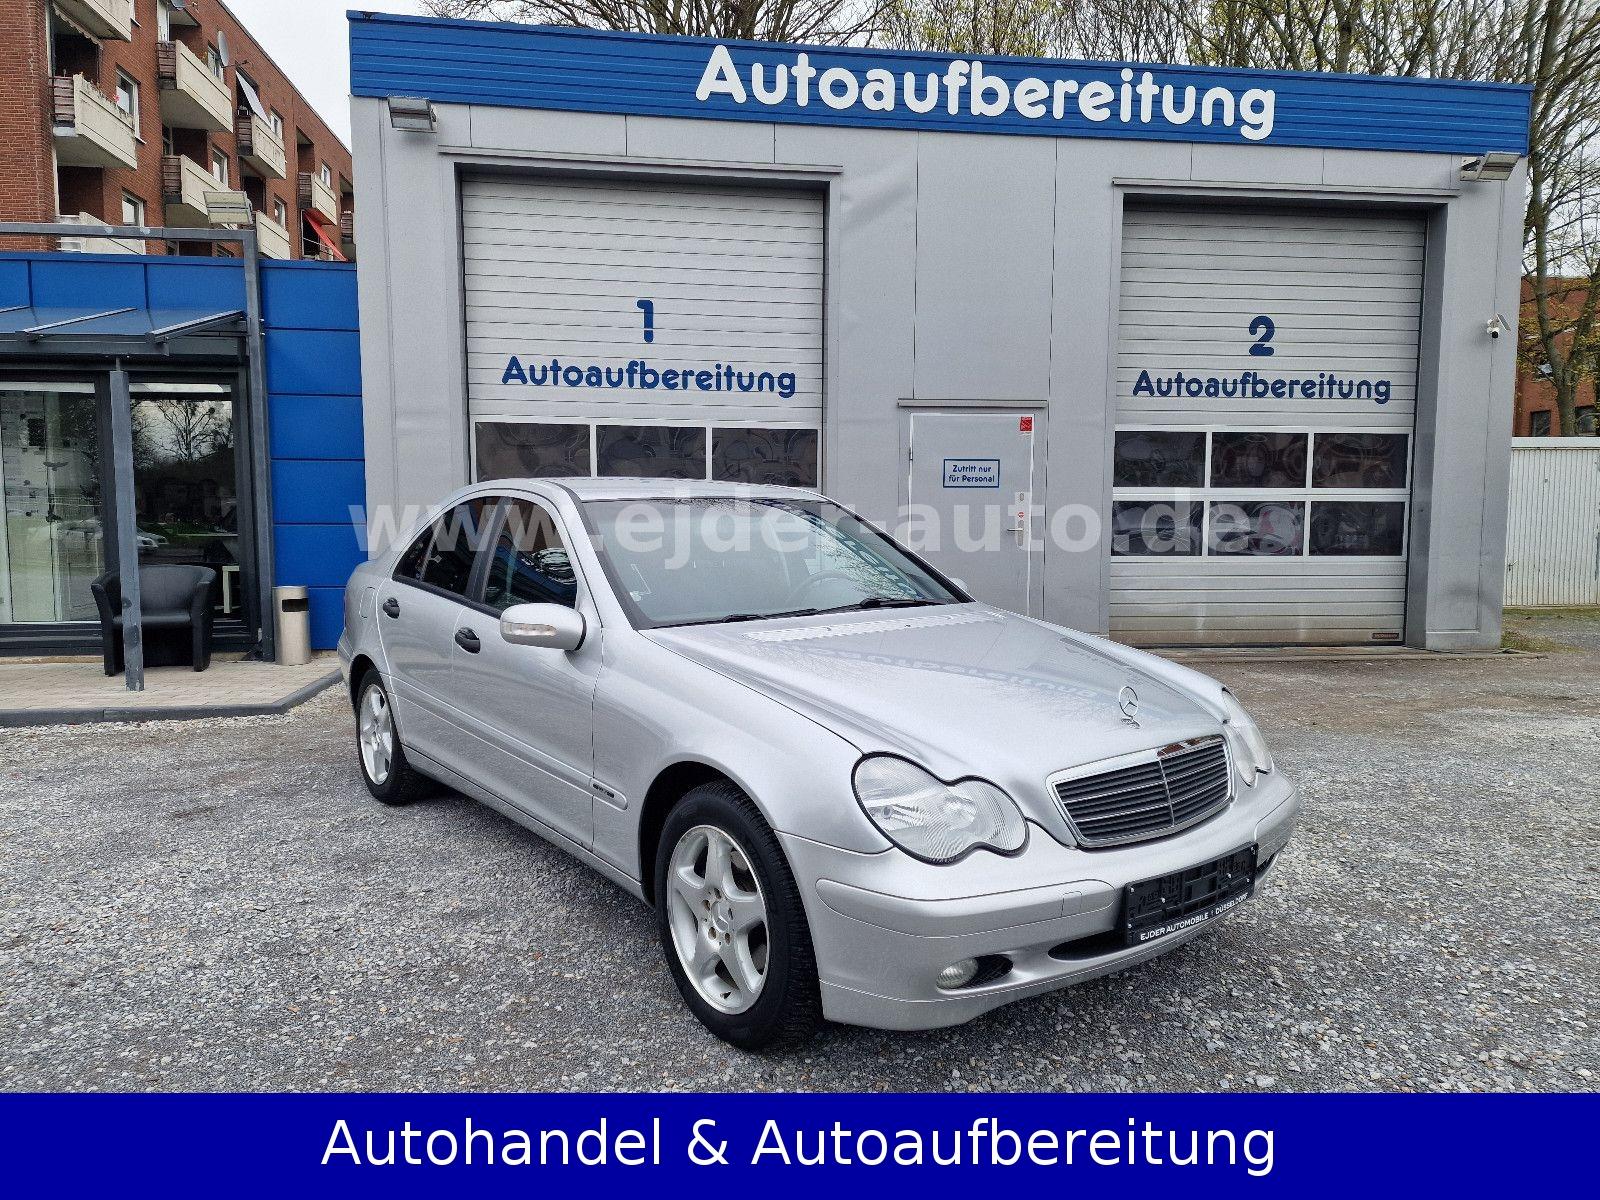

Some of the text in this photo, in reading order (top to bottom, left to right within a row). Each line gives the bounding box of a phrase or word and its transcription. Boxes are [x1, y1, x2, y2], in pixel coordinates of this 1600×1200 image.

[695, 44, 1276, 141] Autoaufbereitung
[636, 299, 655, 344] 1
[1248, 315, 1275, 357] 2
[502, 356, 796, 399] Autoaufbereitung
[1133, 370, 1391, 404] Autoaufbereitung
[948, 474, 995, 483] für Personal
[952, 464, 977, 473] Zutritt
[1140, 927, 1165, 941] EJDER
[1166, 912, 1209, 934] AUTOMOBILE
